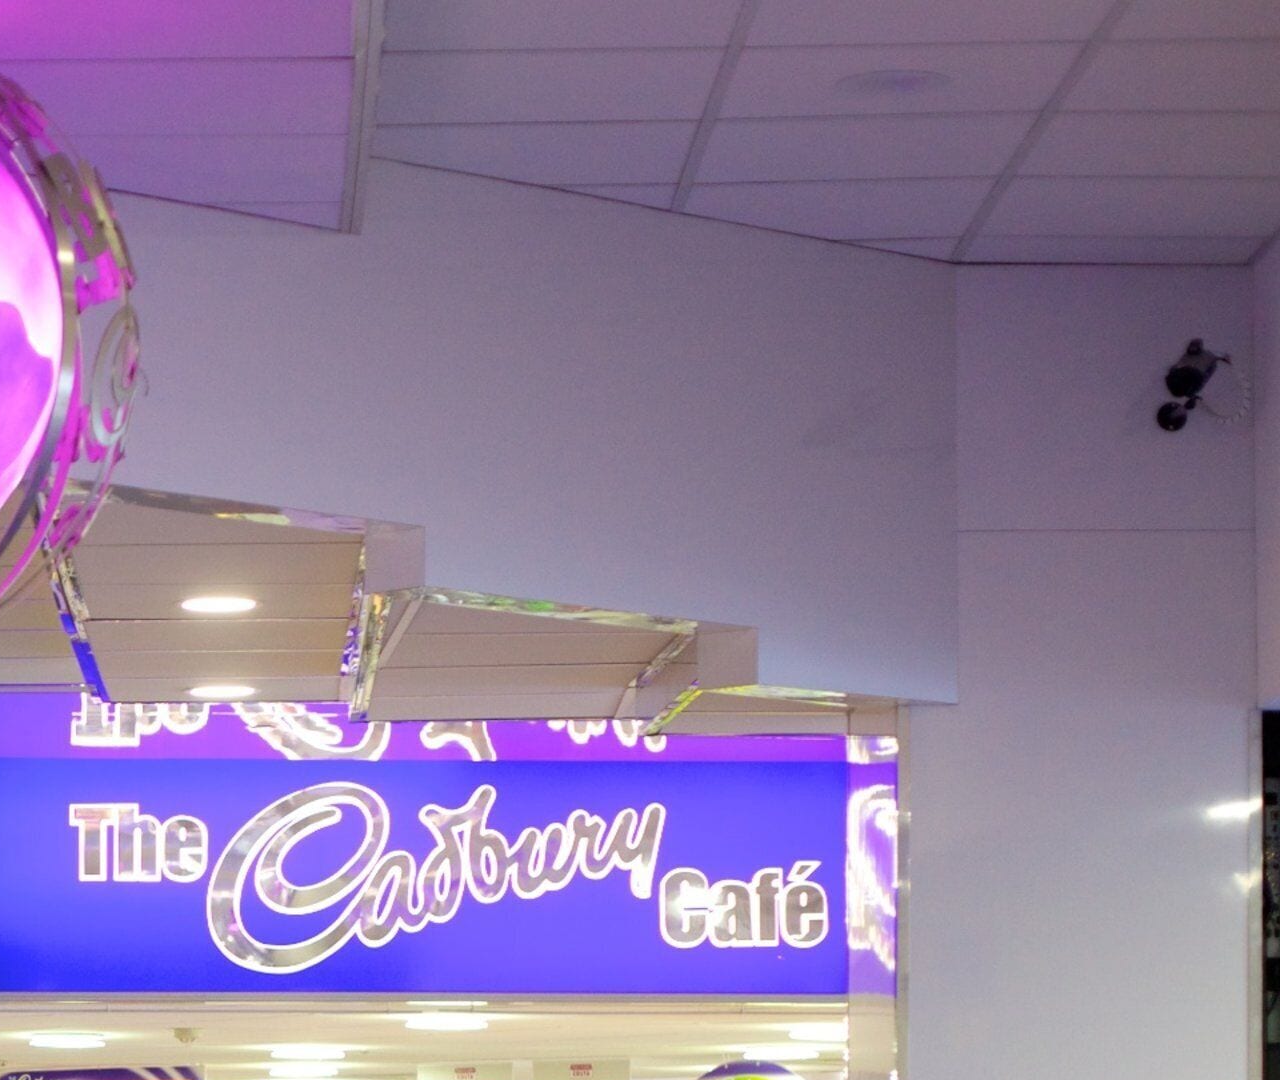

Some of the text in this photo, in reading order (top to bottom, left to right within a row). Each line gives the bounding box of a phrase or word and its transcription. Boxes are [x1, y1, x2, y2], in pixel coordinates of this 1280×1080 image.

[67, 781, 830, 976] The Cadbury Café
